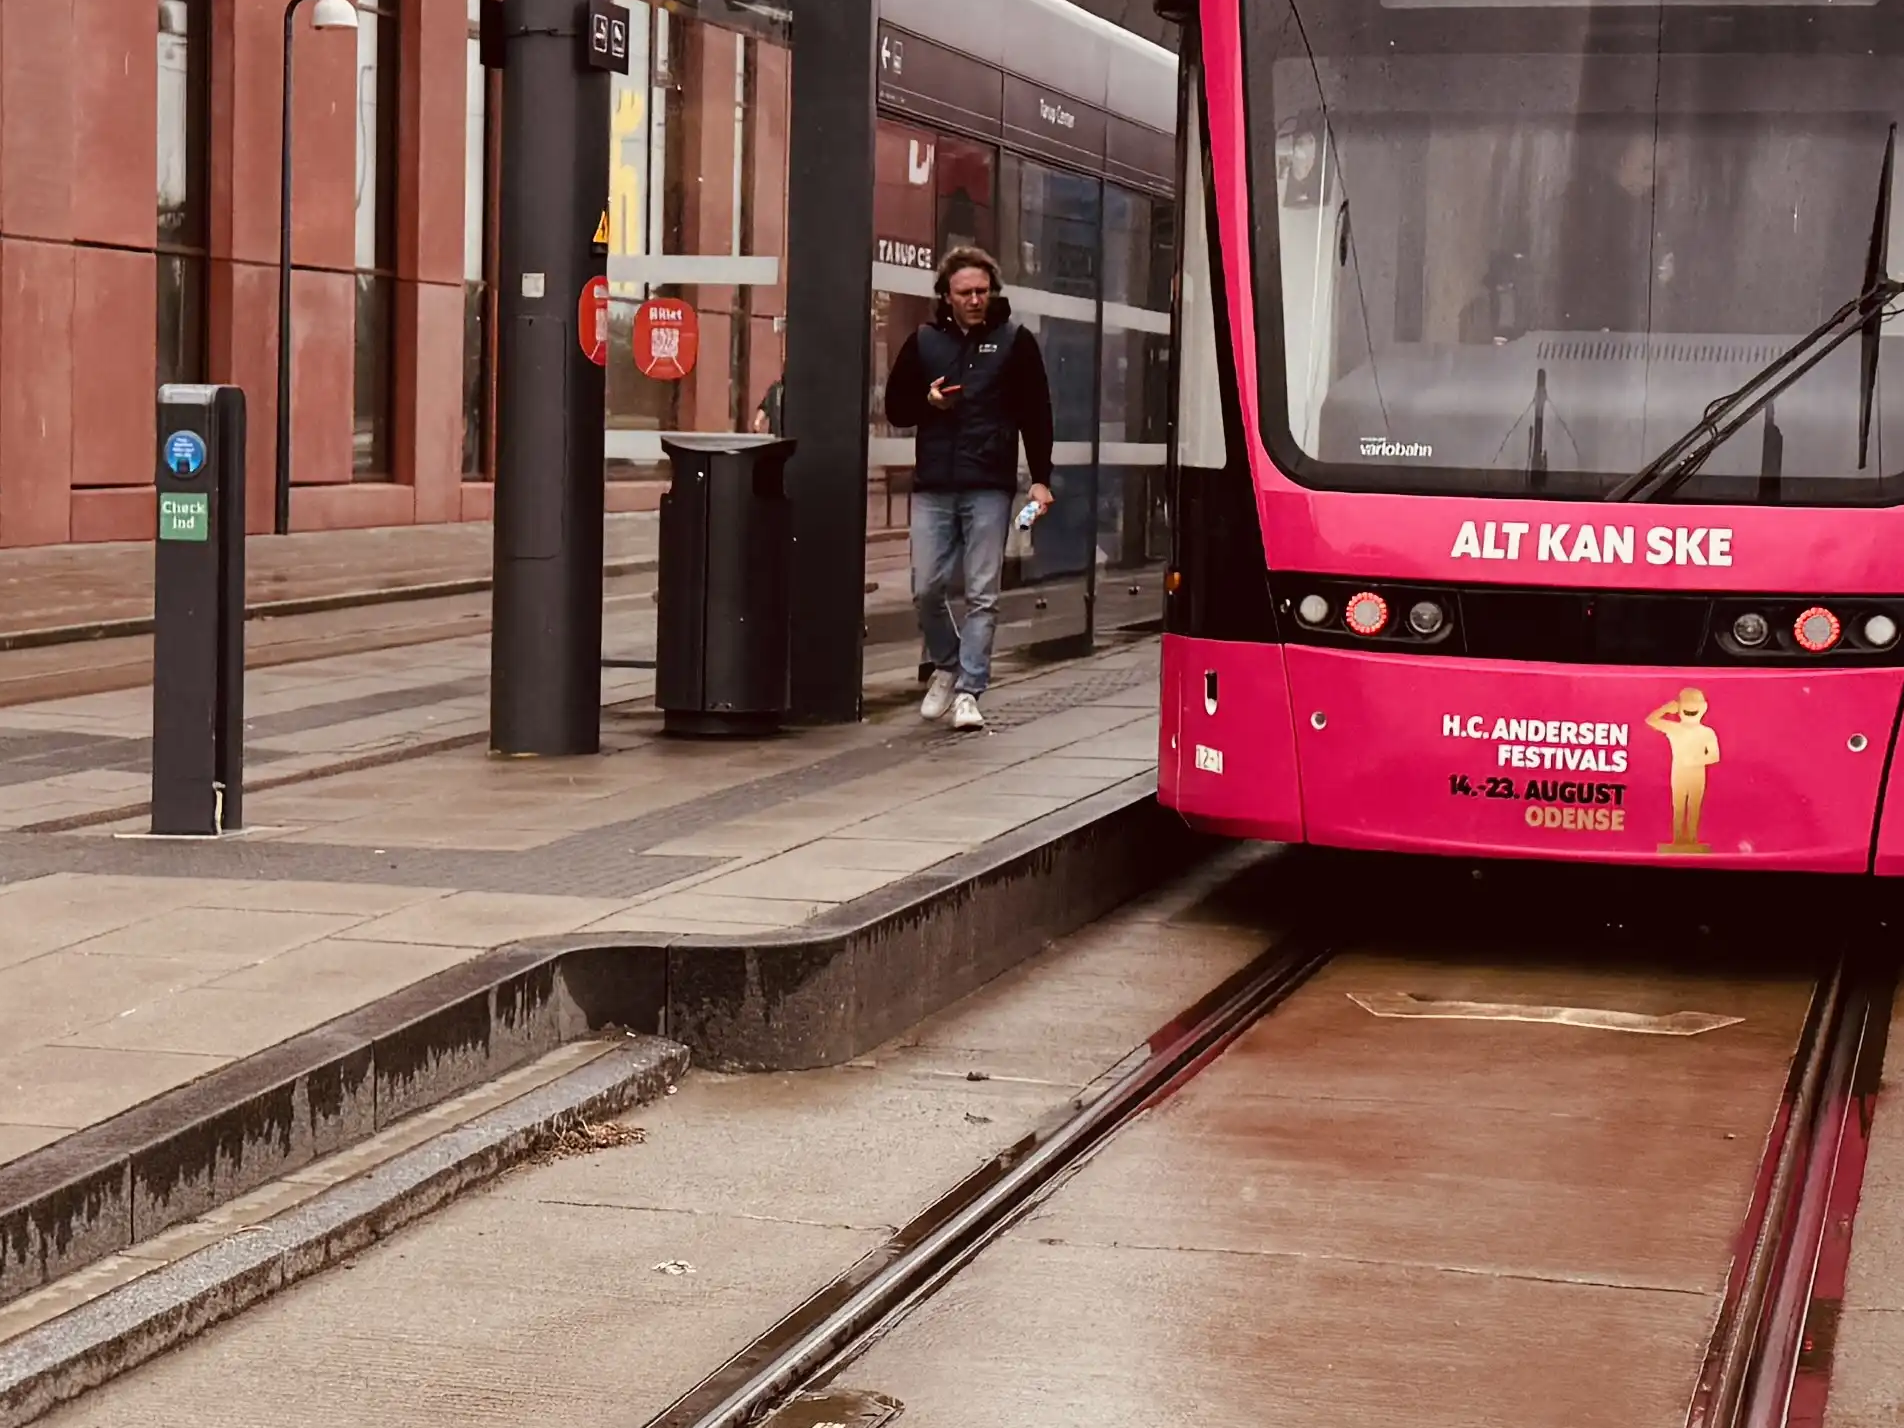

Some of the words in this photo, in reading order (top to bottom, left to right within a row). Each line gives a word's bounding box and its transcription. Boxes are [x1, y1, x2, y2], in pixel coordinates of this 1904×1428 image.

[162, 500, 205, 515] Check
[1450, 521, 1530, 560] ALT
[1537, 523, 1635, 564] KAN
[1645, 526, 1734, 567] SKE
[1491, 718, 1628, 747] ANDERSEN
[1197, 748, 1221, 772] 12-1
[1498, 744, 1628, 773] FESTIVALS
[1449, 774, 1521, 800] 14.-23.
[1524, 780, 1627, 806] AUGUST
[1525, 805, 1626, 832] ODENSE
